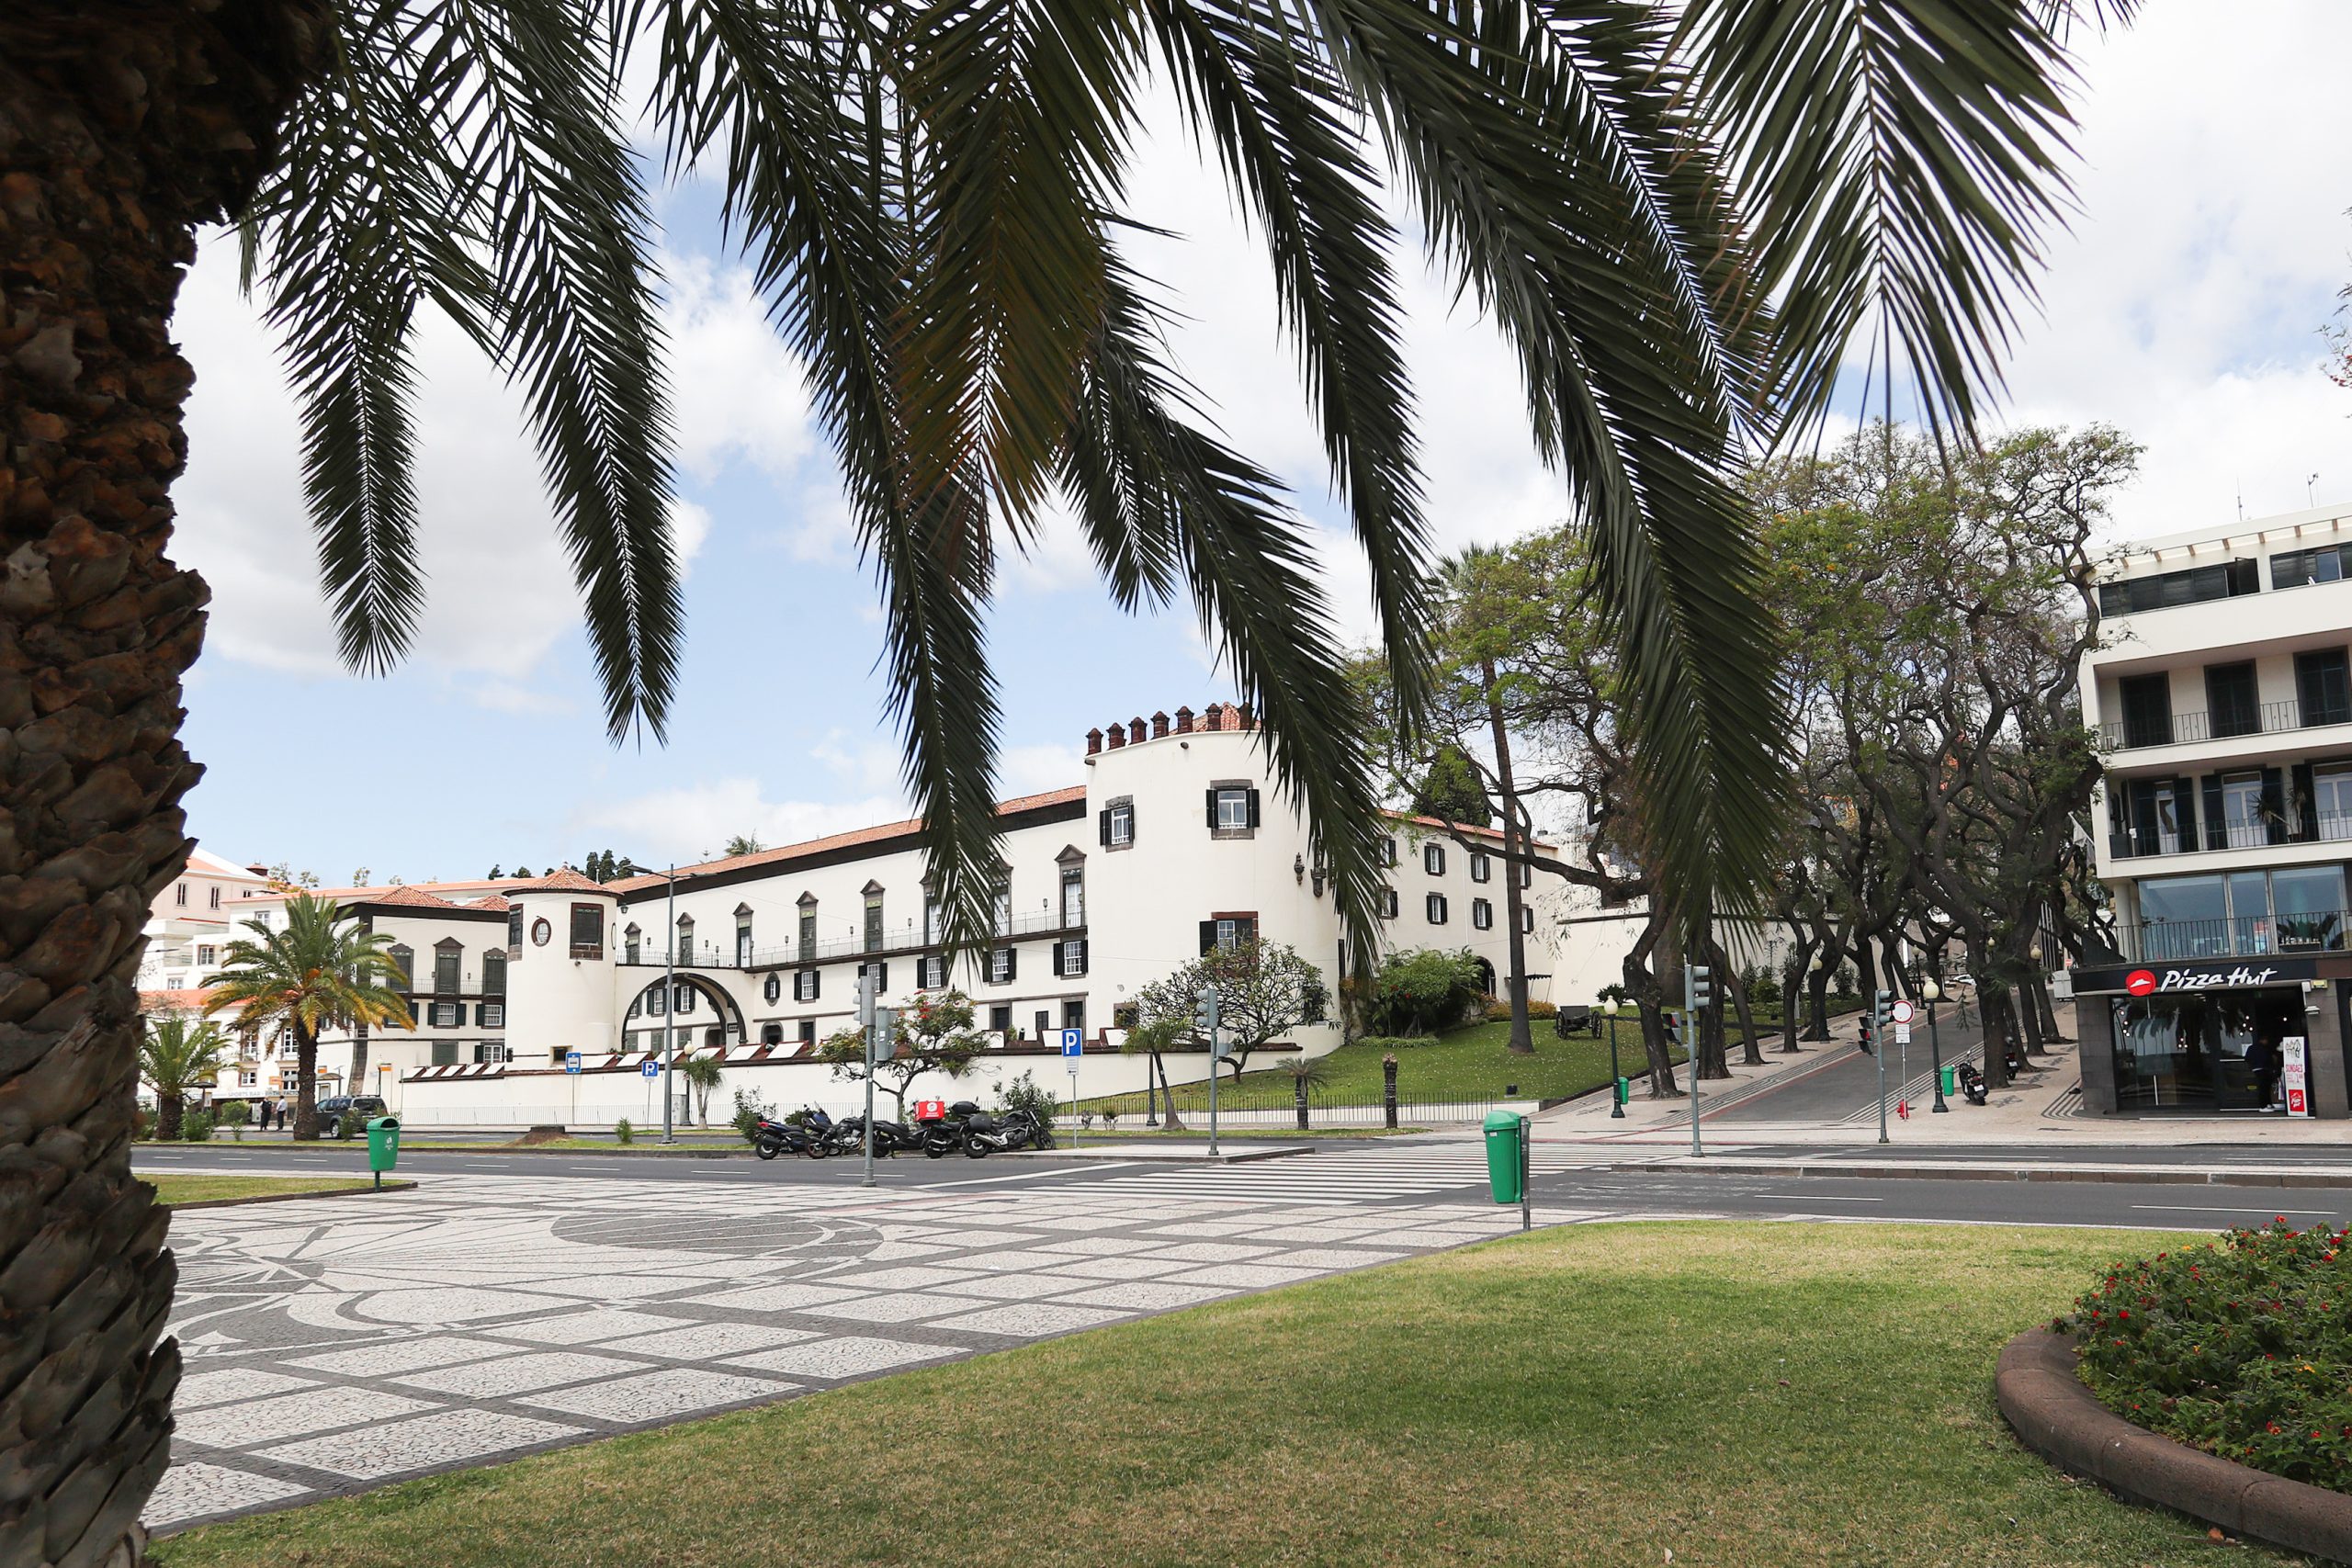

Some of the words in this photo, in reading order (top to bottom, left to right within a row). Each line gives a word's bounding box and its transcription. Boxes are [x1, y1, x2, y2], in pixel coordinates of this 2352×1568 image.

[2160, 968, 2223, 992] Pizza
[2226, 966, 2278, 987] Hut
[1066, 1032, 1078, 1055] P
[645, 1063, 655, 1076] P
